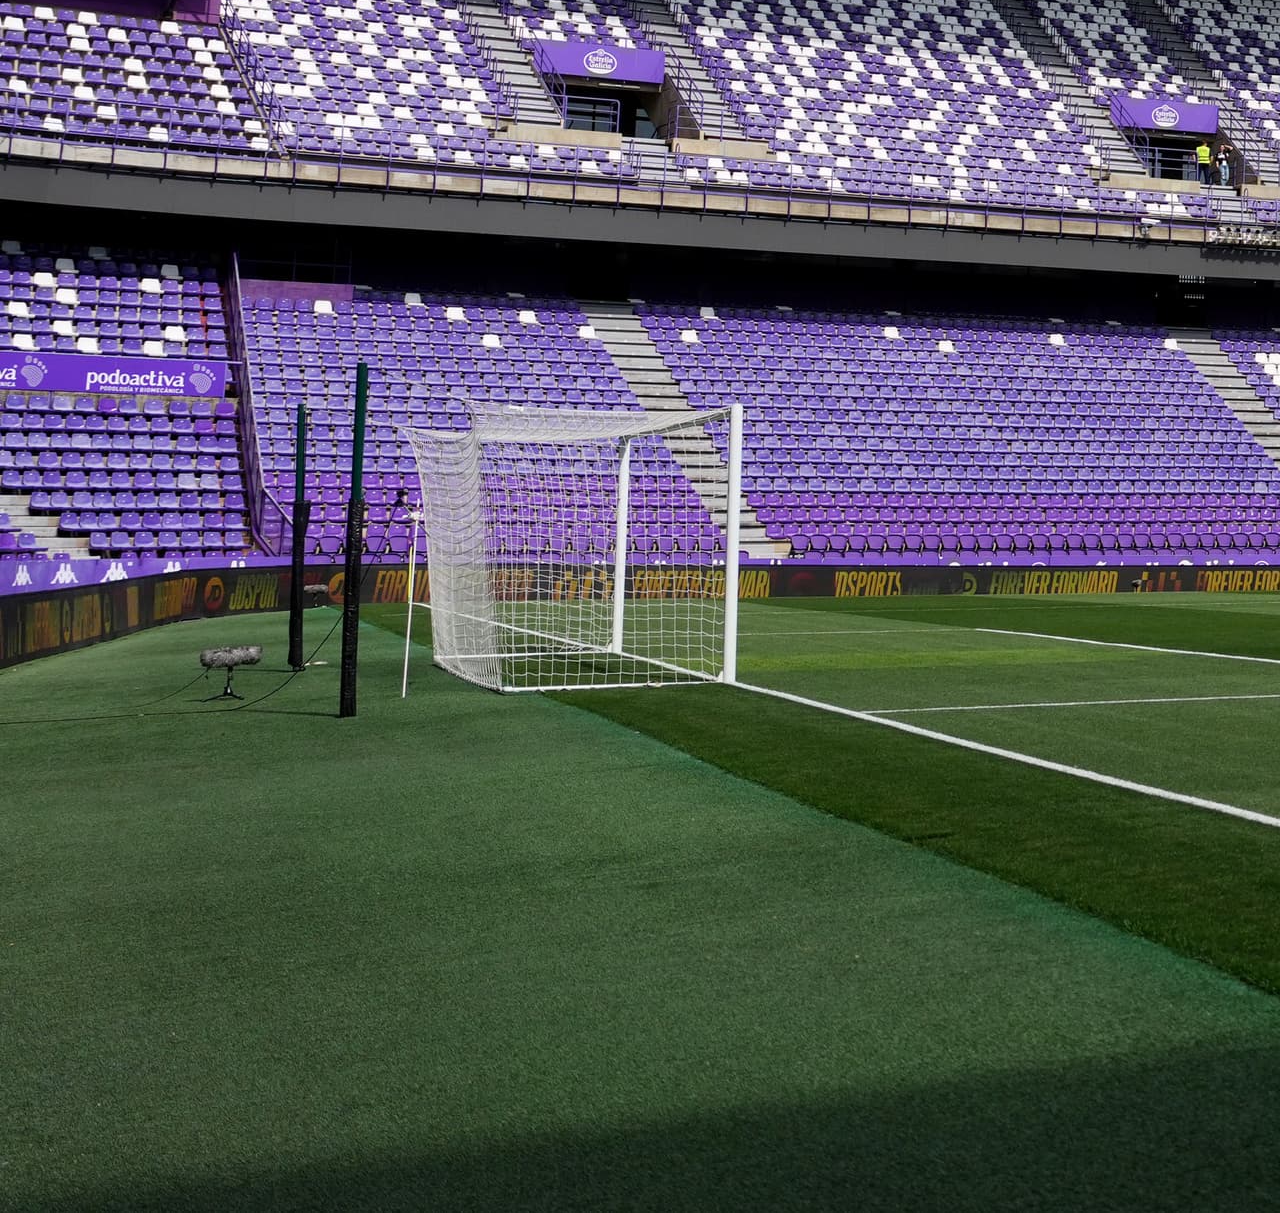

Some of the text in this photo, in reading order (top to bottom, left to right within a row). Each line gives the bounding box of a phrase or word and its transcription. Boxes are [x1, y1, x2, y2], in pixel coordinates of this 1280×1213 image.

[85, 368, 185, 390] podoactiva
[989, 571, 1118, 595] FOREVER FORWARD
[1196, 570, 1253, 592] FOREVER
